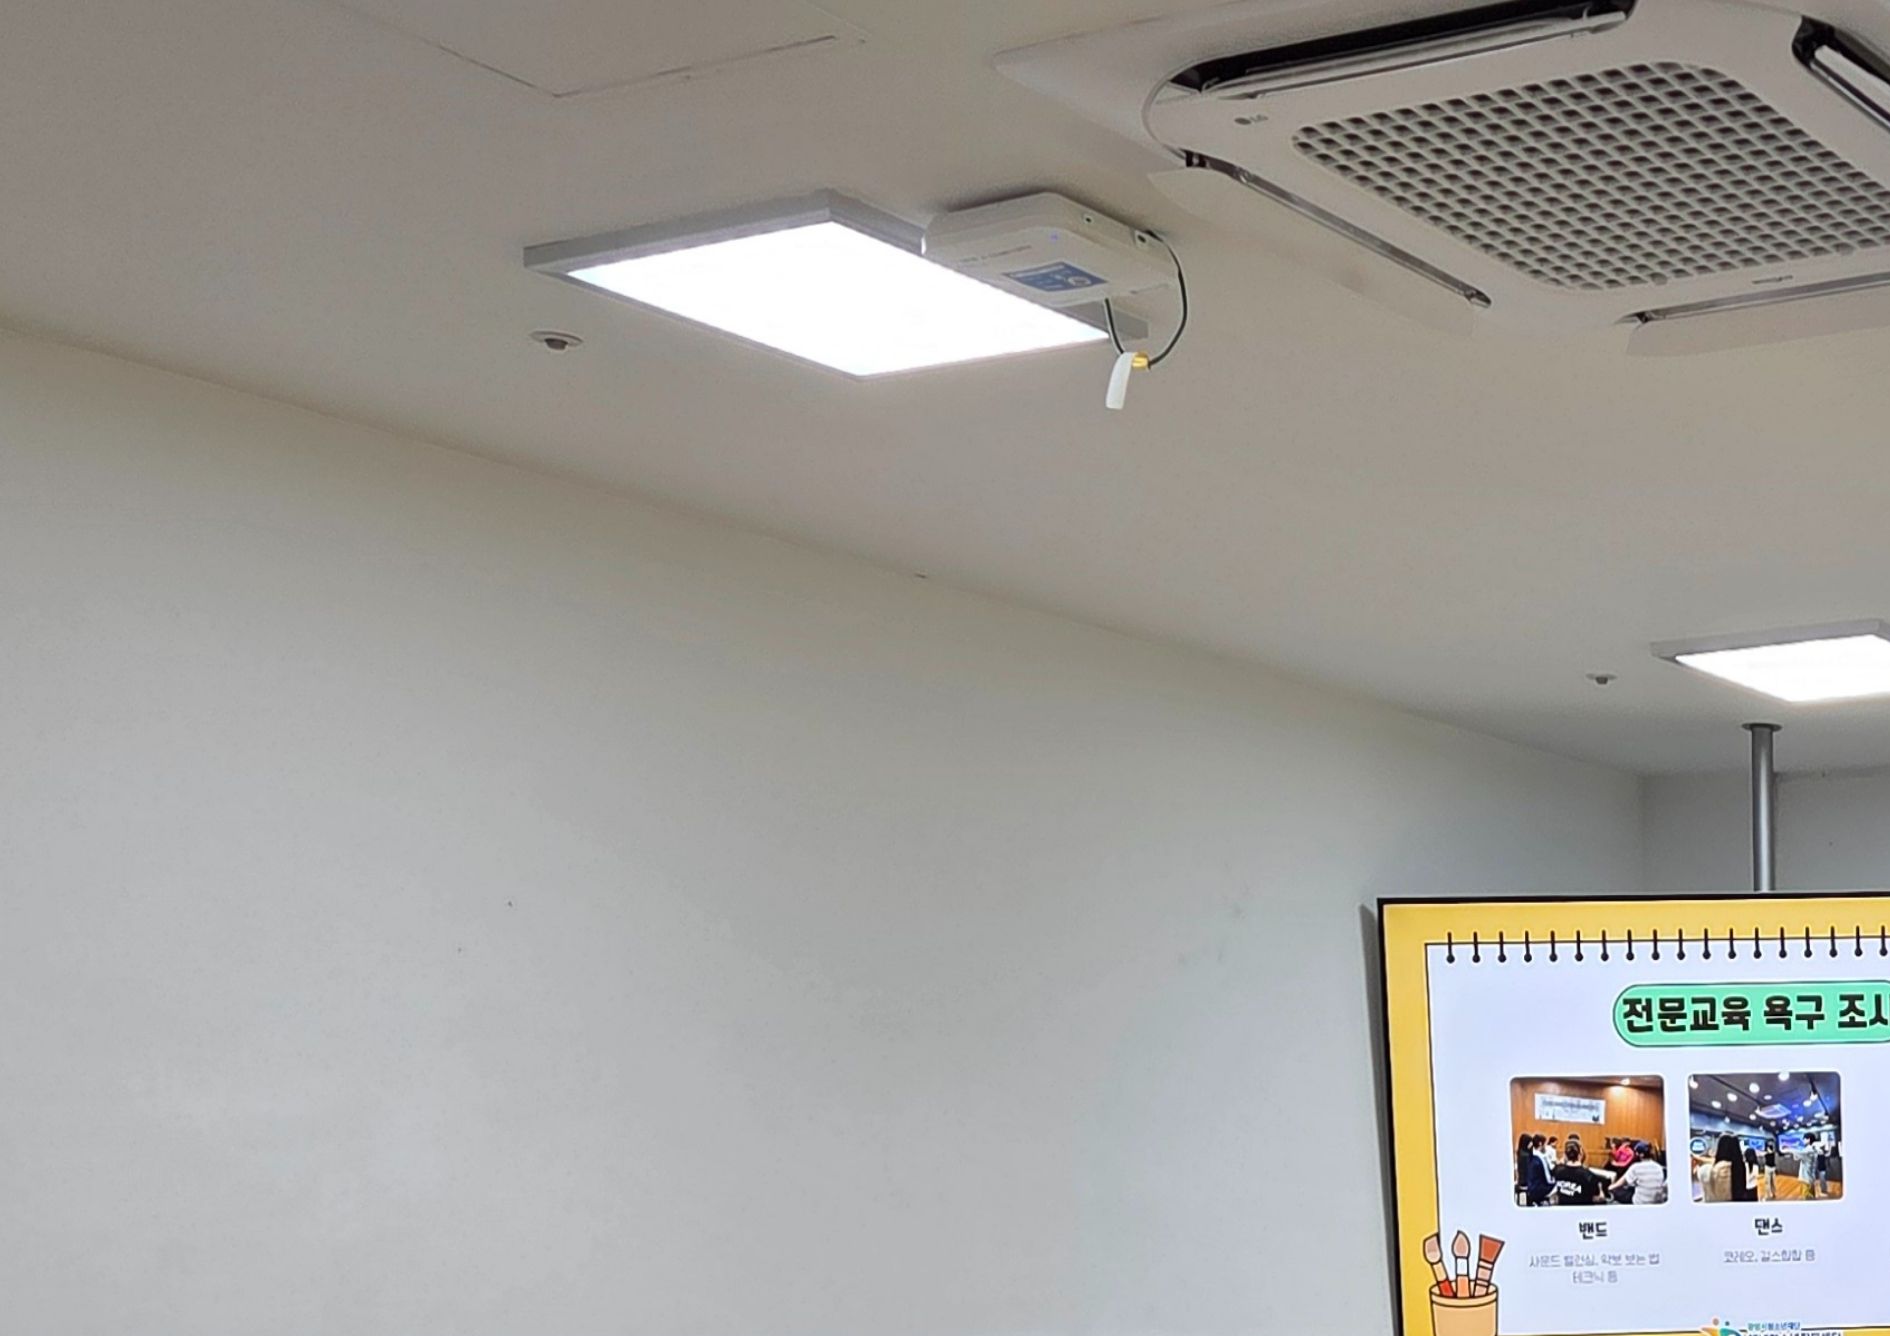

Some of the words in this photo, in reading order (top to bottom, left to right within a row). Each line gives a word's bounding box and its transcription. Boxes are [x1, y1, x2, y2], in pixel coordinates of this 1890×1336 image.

[1622, 996, 1752, 1033] 전문교육
[1763, 995, 1825, 1030] 욕구
[1578, 1221, 1608, 1239] 밴드
[1754, 1218, 1783, 1235] 댄스
